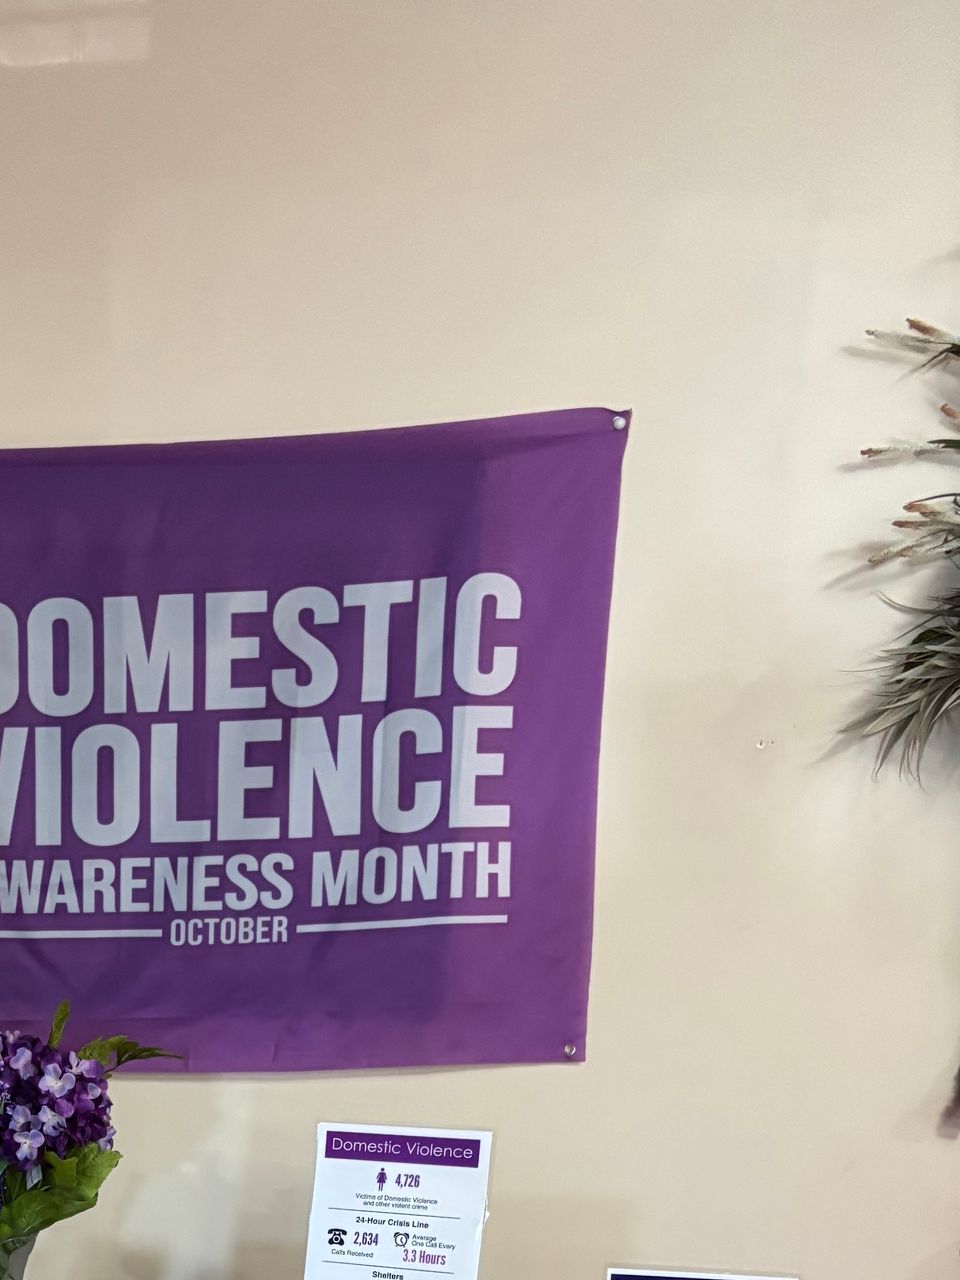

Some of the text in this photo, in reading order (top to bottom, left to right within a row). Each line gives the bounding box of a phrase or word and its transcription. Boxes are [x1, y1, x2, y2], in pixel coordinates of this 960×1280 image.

[311, 841, 511, 908] MONTH
[169, 916, 288, 946] OCTOBER
[332, 1138, 472, 1158] Domestic Violence
[395, 1174, 420, 1188] 4,726
[385, 1195, 411, 1203] Domestic
[356, 1217, 386, 1225] 24-Hour
[388, 1219, 410, 1227] Crisis
[354, 1232, 379, 1246] 2,634
[412, 1234, 436, 1243] Average
[439, 1243, 456, 1251] Every
[347, 1250, 373, 1258] Received
[403, 1249, 446, 1265] 3.3 Hours
[372, 1271, 404, 1280] Shelters
